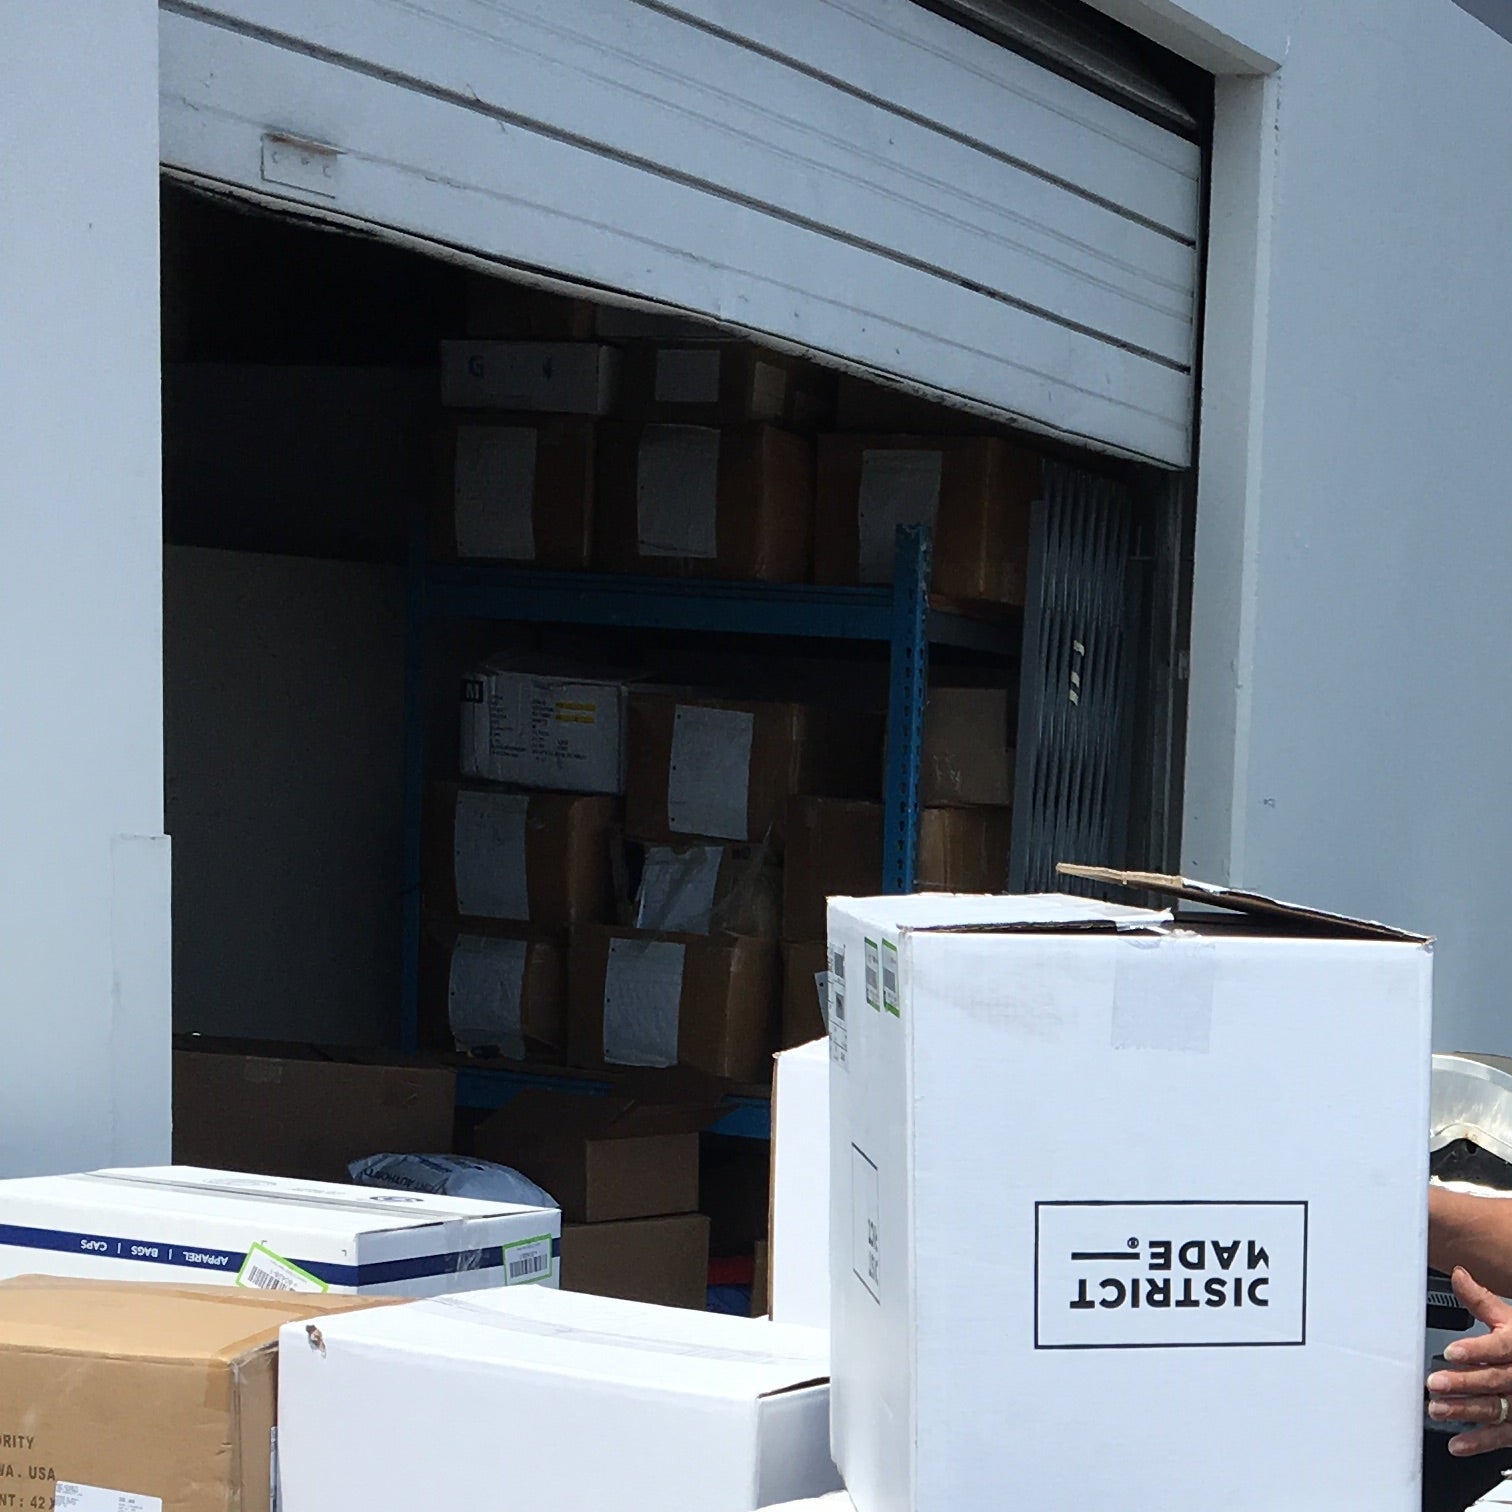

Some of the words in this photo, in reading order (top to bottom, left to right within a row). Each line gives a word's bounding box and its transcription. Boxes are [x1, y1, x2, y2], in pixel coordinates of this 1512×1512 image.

[80, 1239, 108, 1251] CAPS
[131, 1245, 159, 1258] BAGS
[182, 1251, 229, 1266] APPAREL
[1069, 1277, 1270, 1309] DISTRICT
